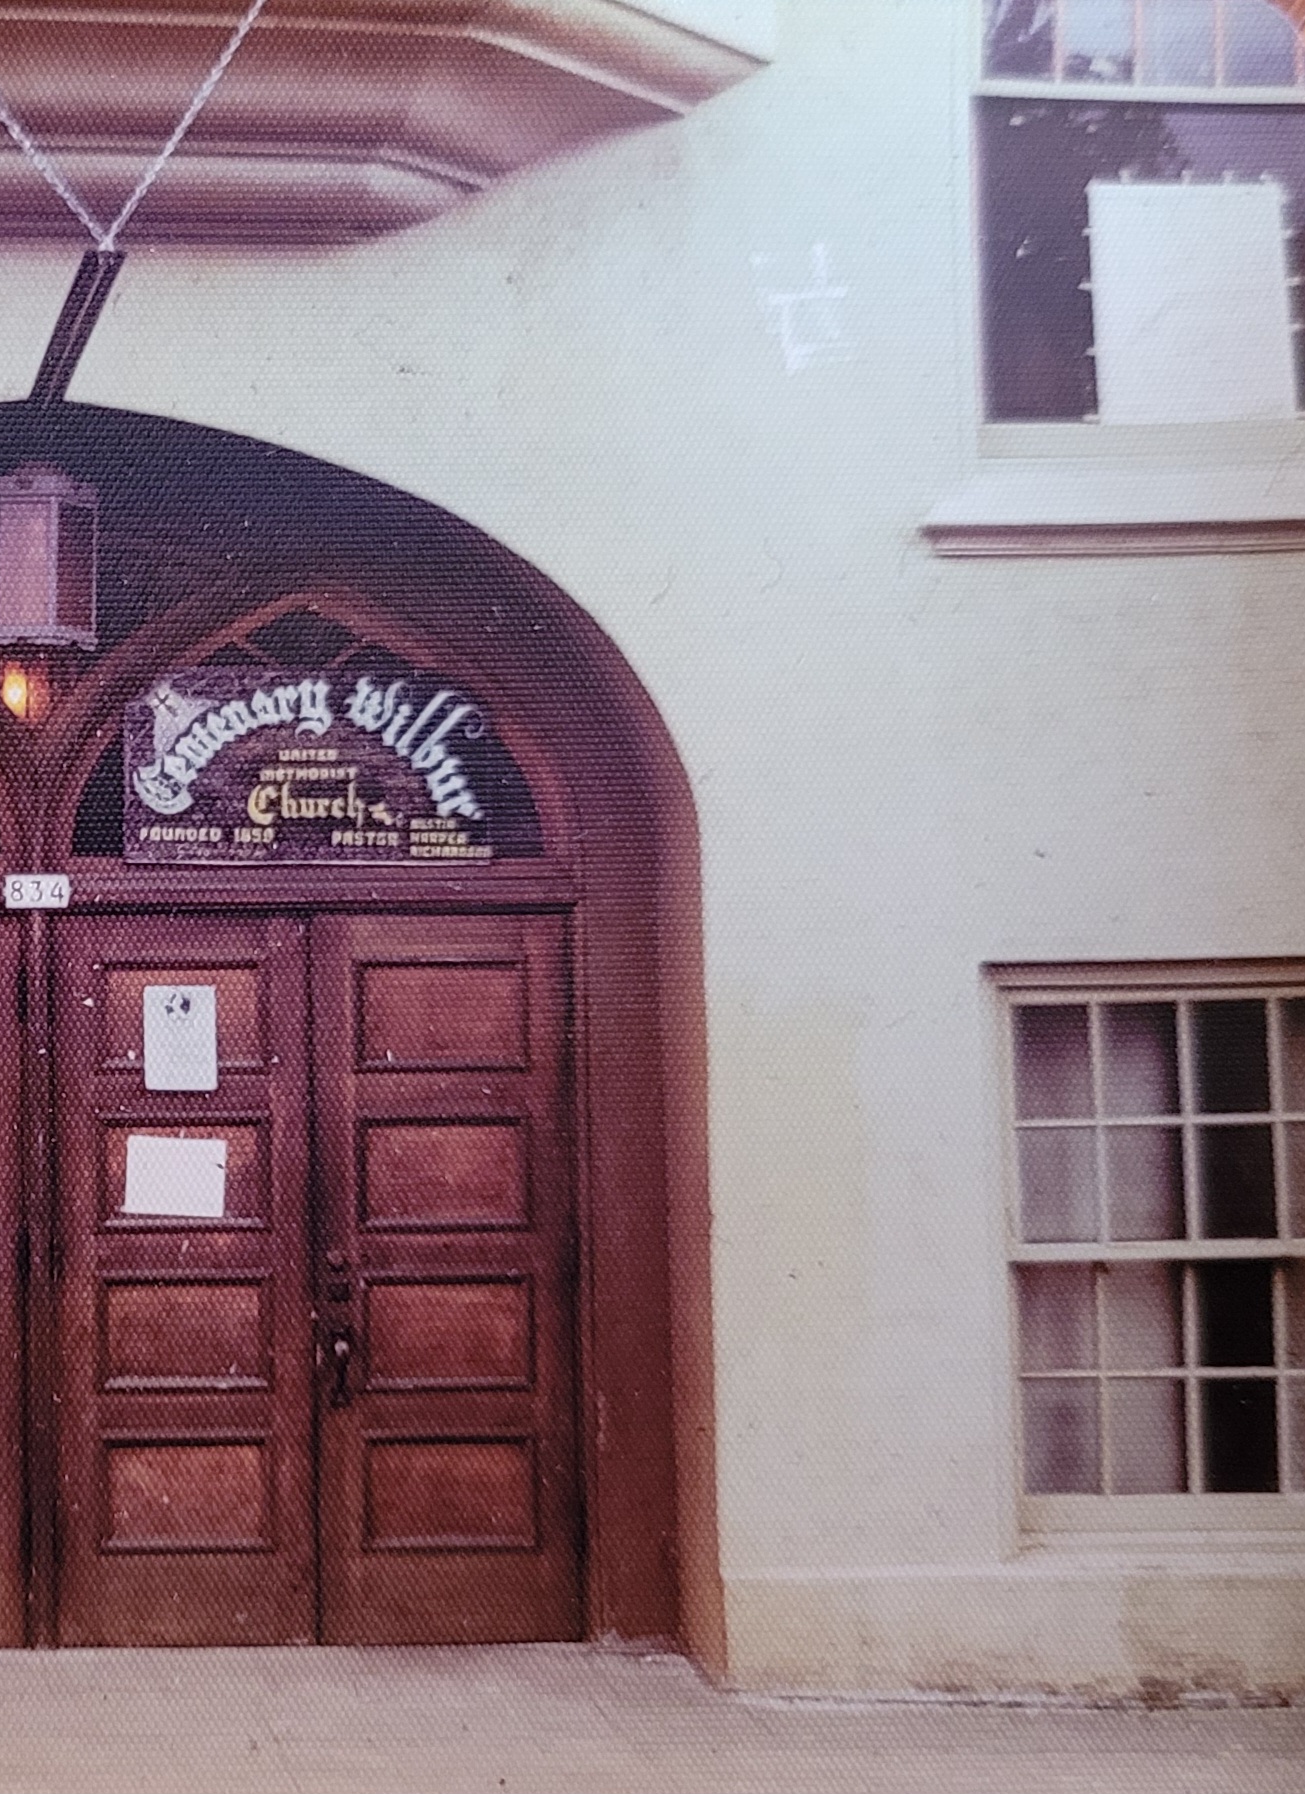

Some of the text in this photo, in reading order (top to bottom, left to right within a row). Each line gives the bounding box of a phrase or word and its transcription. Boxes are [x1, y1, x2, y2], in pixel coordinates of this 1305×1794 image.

[278, 749, 340, 762] UNITED
[258, 767, 358, 782] METHODIST
[247, 780, 366, 828] Church
[139, 827, 222, 842] FOUNDED
[331, 830, 400, 847] PASTOR
[11, 880, 64, 903] 834
